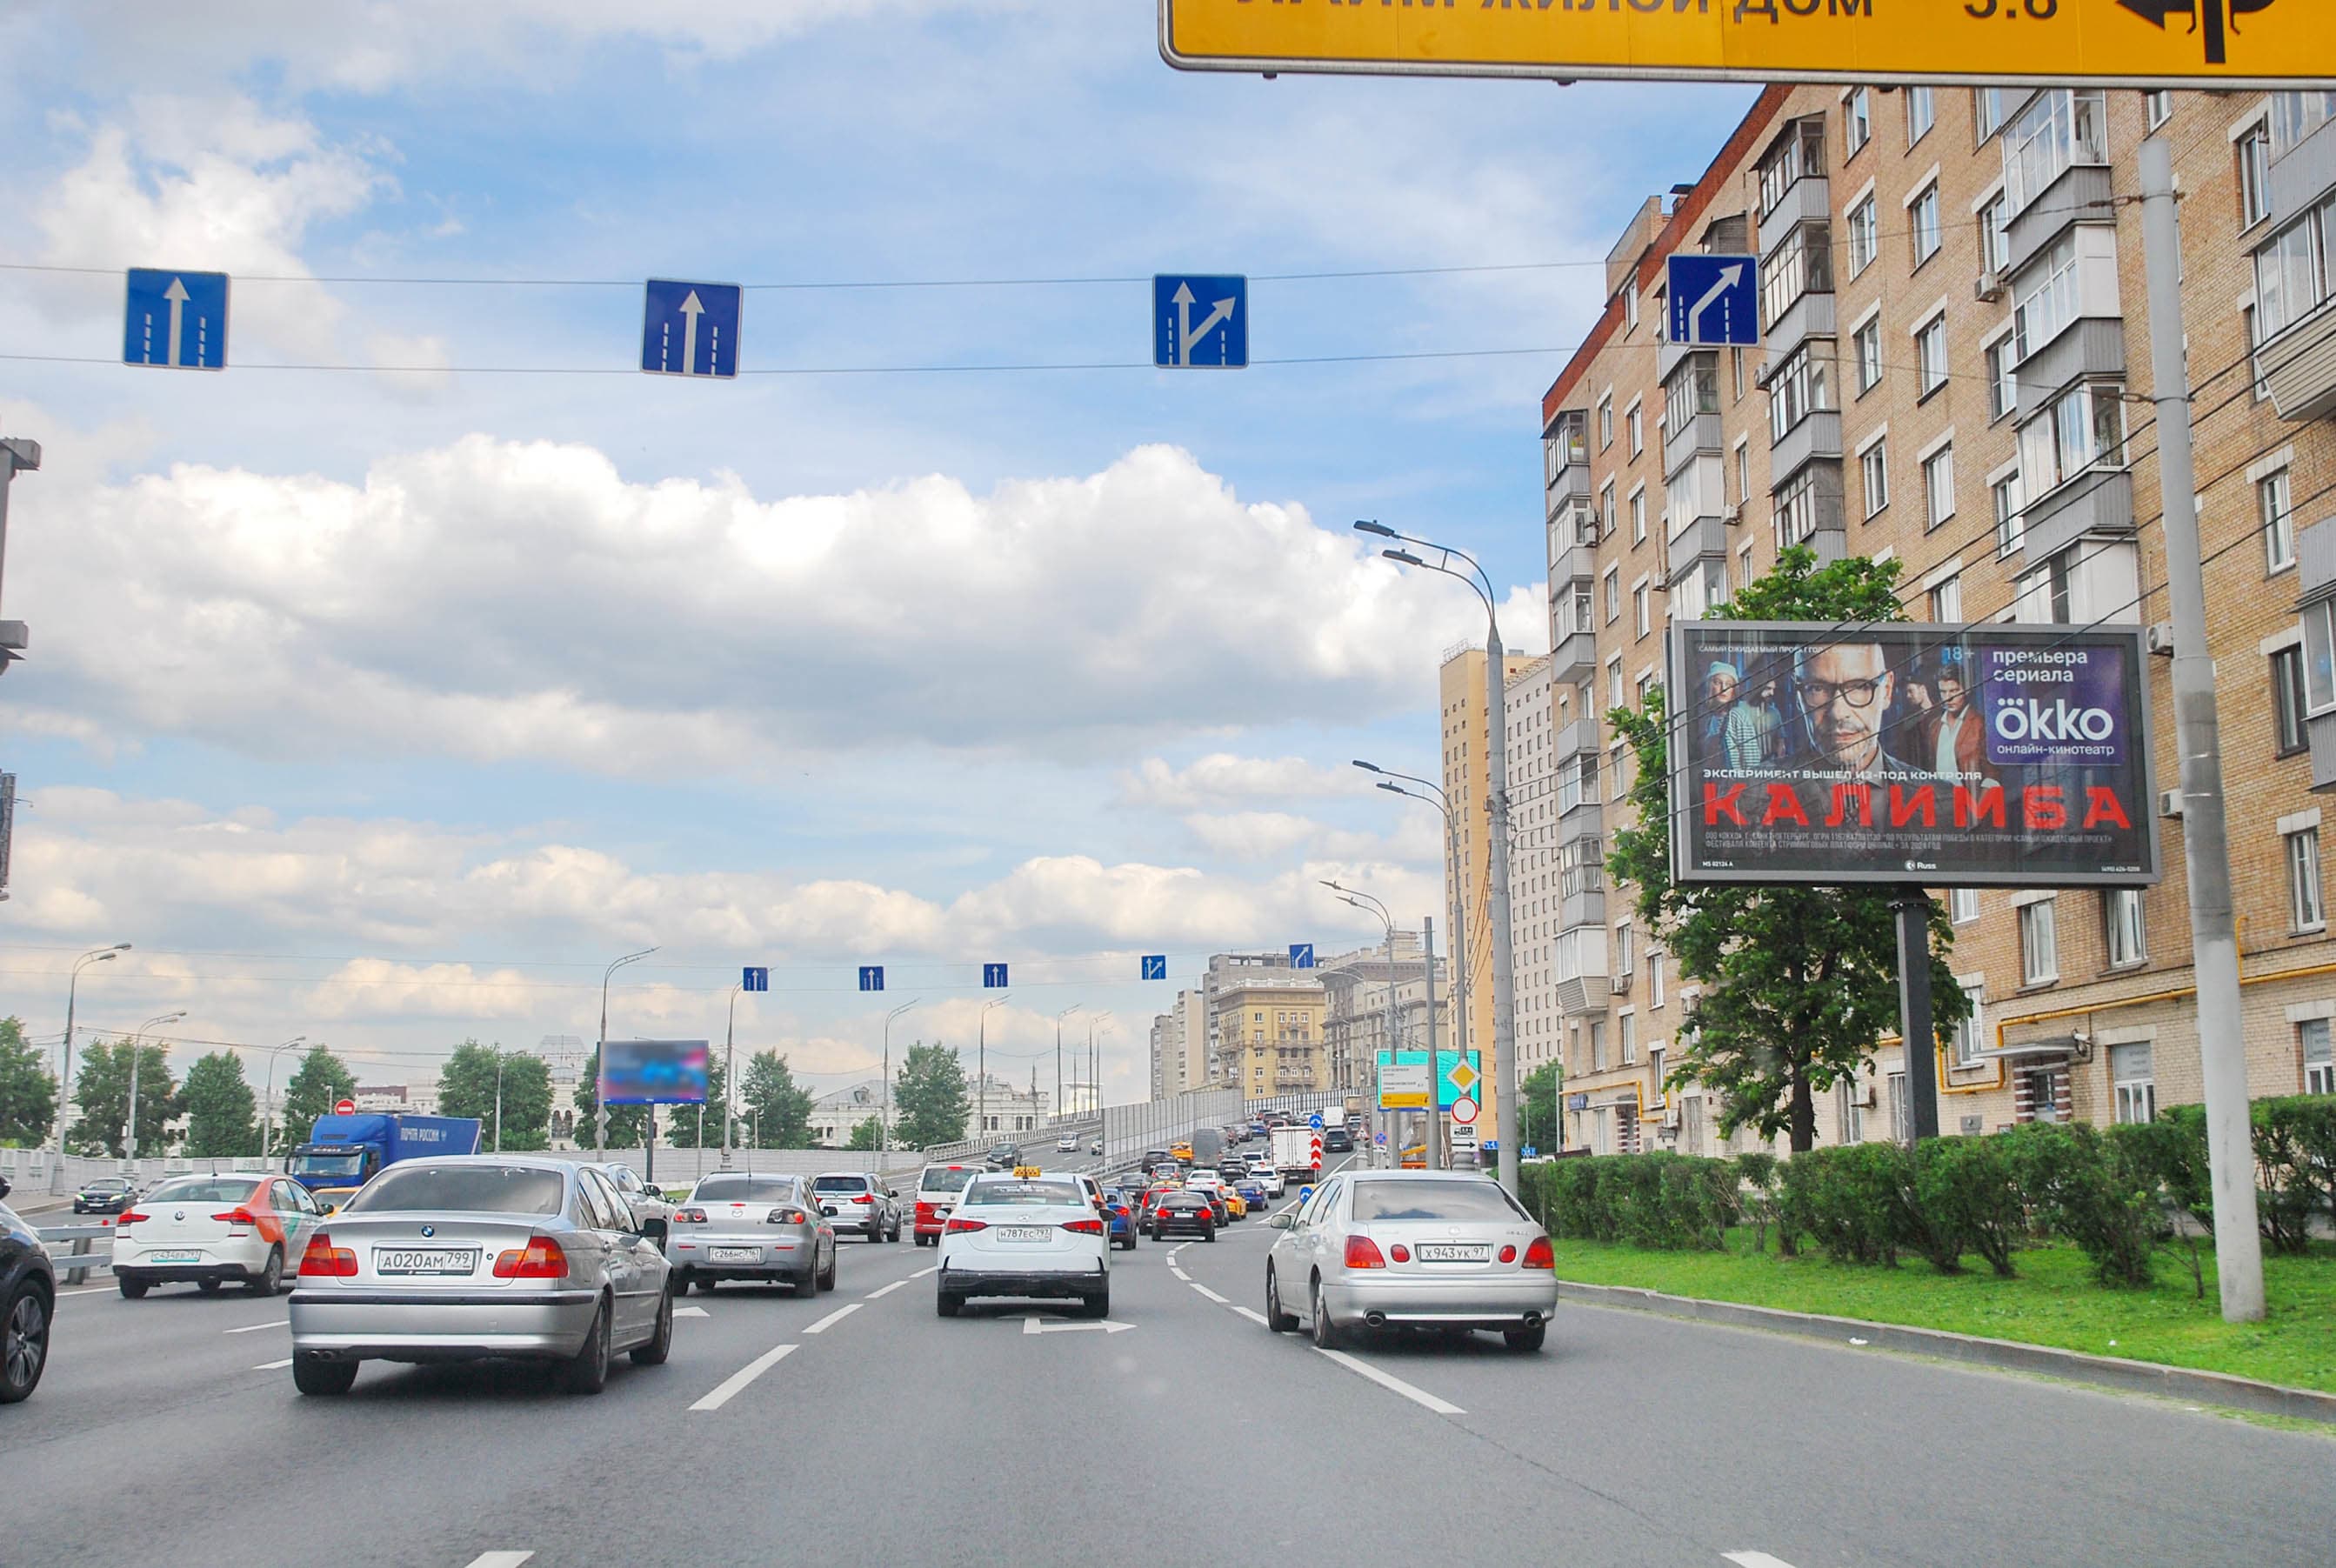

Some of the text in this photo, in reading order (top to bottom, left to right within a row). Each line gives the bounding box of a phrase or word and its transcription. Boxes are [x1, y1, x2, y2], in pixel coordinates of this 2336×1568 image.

[1946, 647, 1975, 661] 18+
[1992, 651, 2088, 665] премьера
[1993, 670, 2074, 684] сериала
[1997, 744, 2115, 757] онлайн-кинотеатр
[1703, 769, 1983, 780] ЭКСПЕРИМЕНТ ВЫШЕЛ ИЗ-ПОД КОНТРОЛЯ
[1703, 783, 2132, 829] КАЛИМБА
[1000, 1229, 1034, 1238] Н787ЕС
[383, 1253, 444, 1268] А020АМ
[1425, 1248, 1470, 1259] Х943УК
